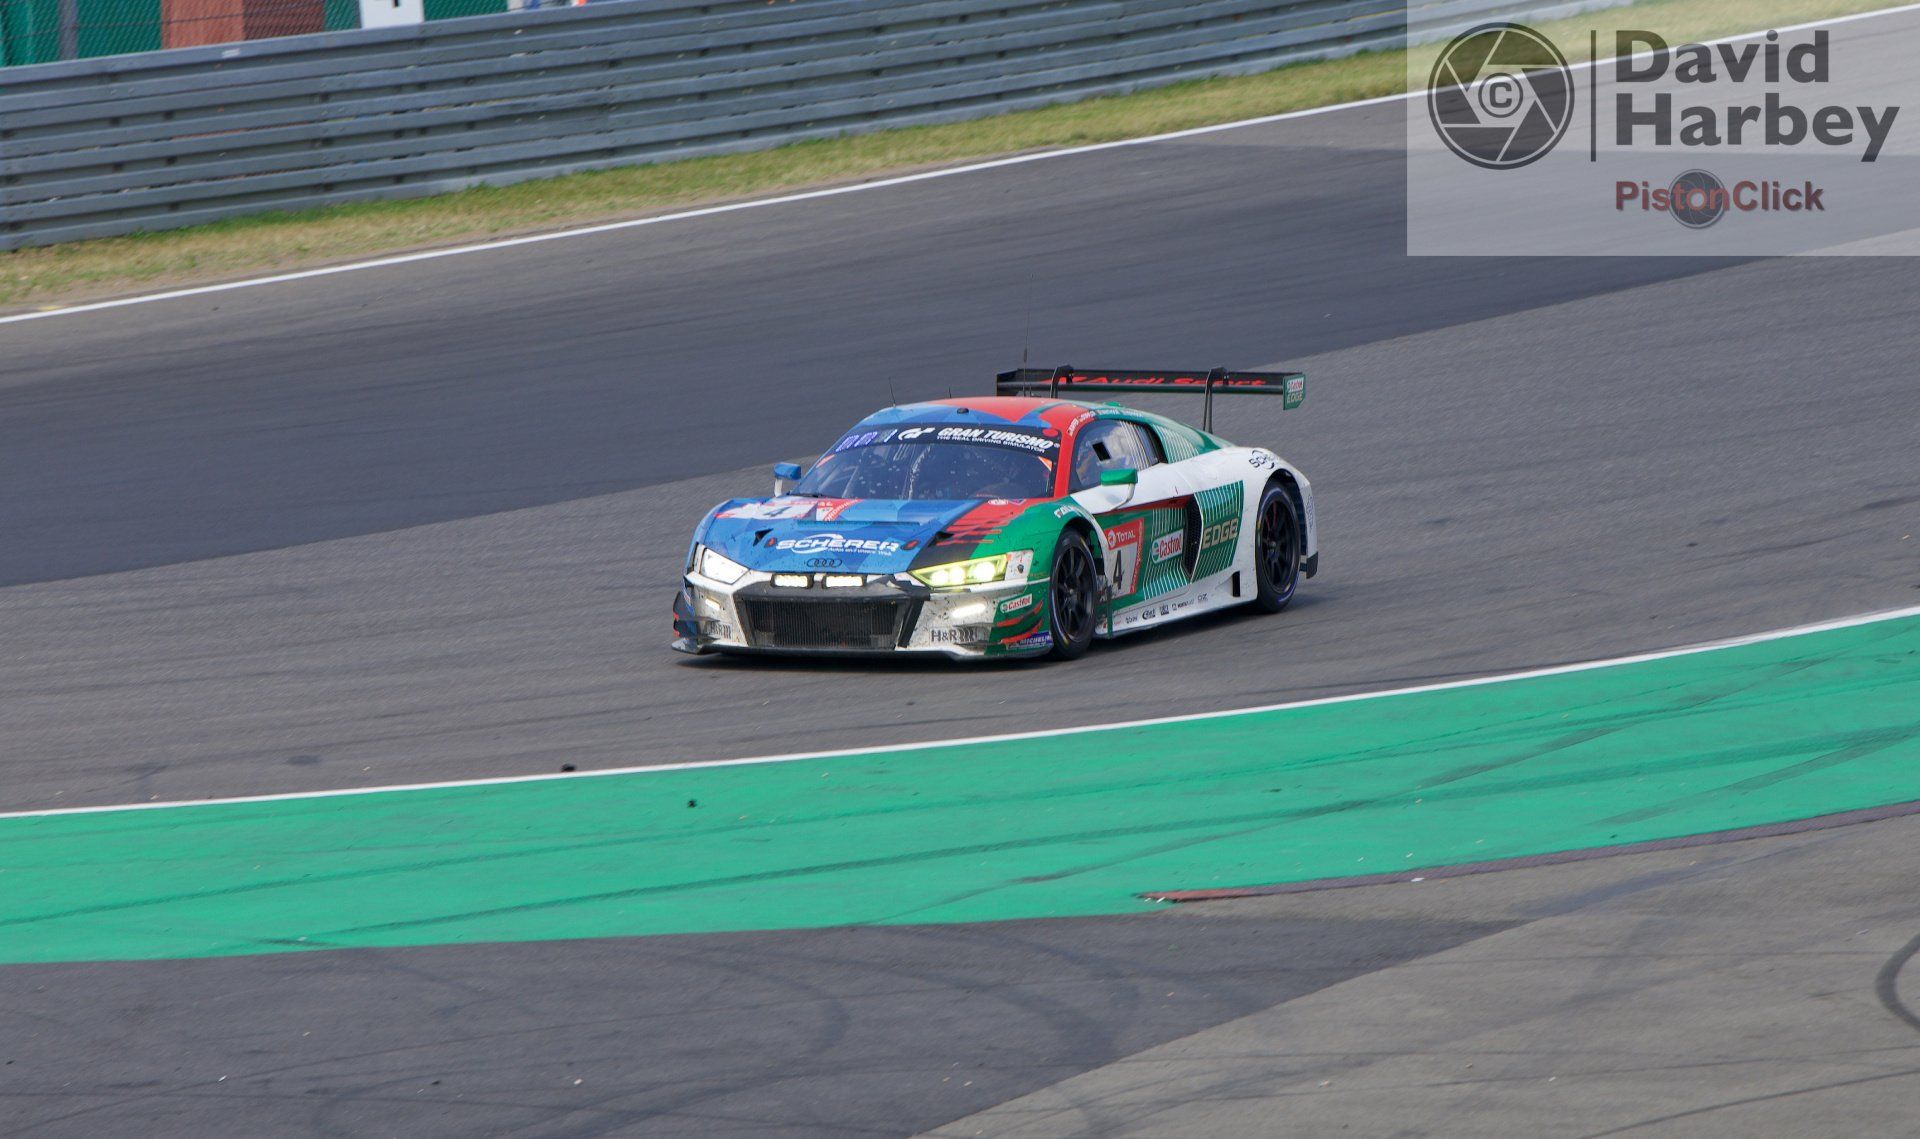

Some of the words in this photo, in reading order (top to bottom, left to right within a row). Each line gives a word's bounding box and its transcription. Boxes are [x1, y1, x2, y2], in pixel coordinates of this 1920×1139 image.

[938, 427, 985, 438] GRAN
[972, 437, 1001, 445] DRIVING
[1003, 440, 1045, 454] SIMULATOR
[1116, 529, 1136, 543] TOTAL
[1202, 518, 1239, 550] EDGE
[776, 538, 900, 552] SCHERER
[1159, 532, 1182, 559] Castrol
[1113, 549, 1124, 590] 4
[1007, 596, 1032, 611] Castrol
[931, 628, 958, 642] H&R
